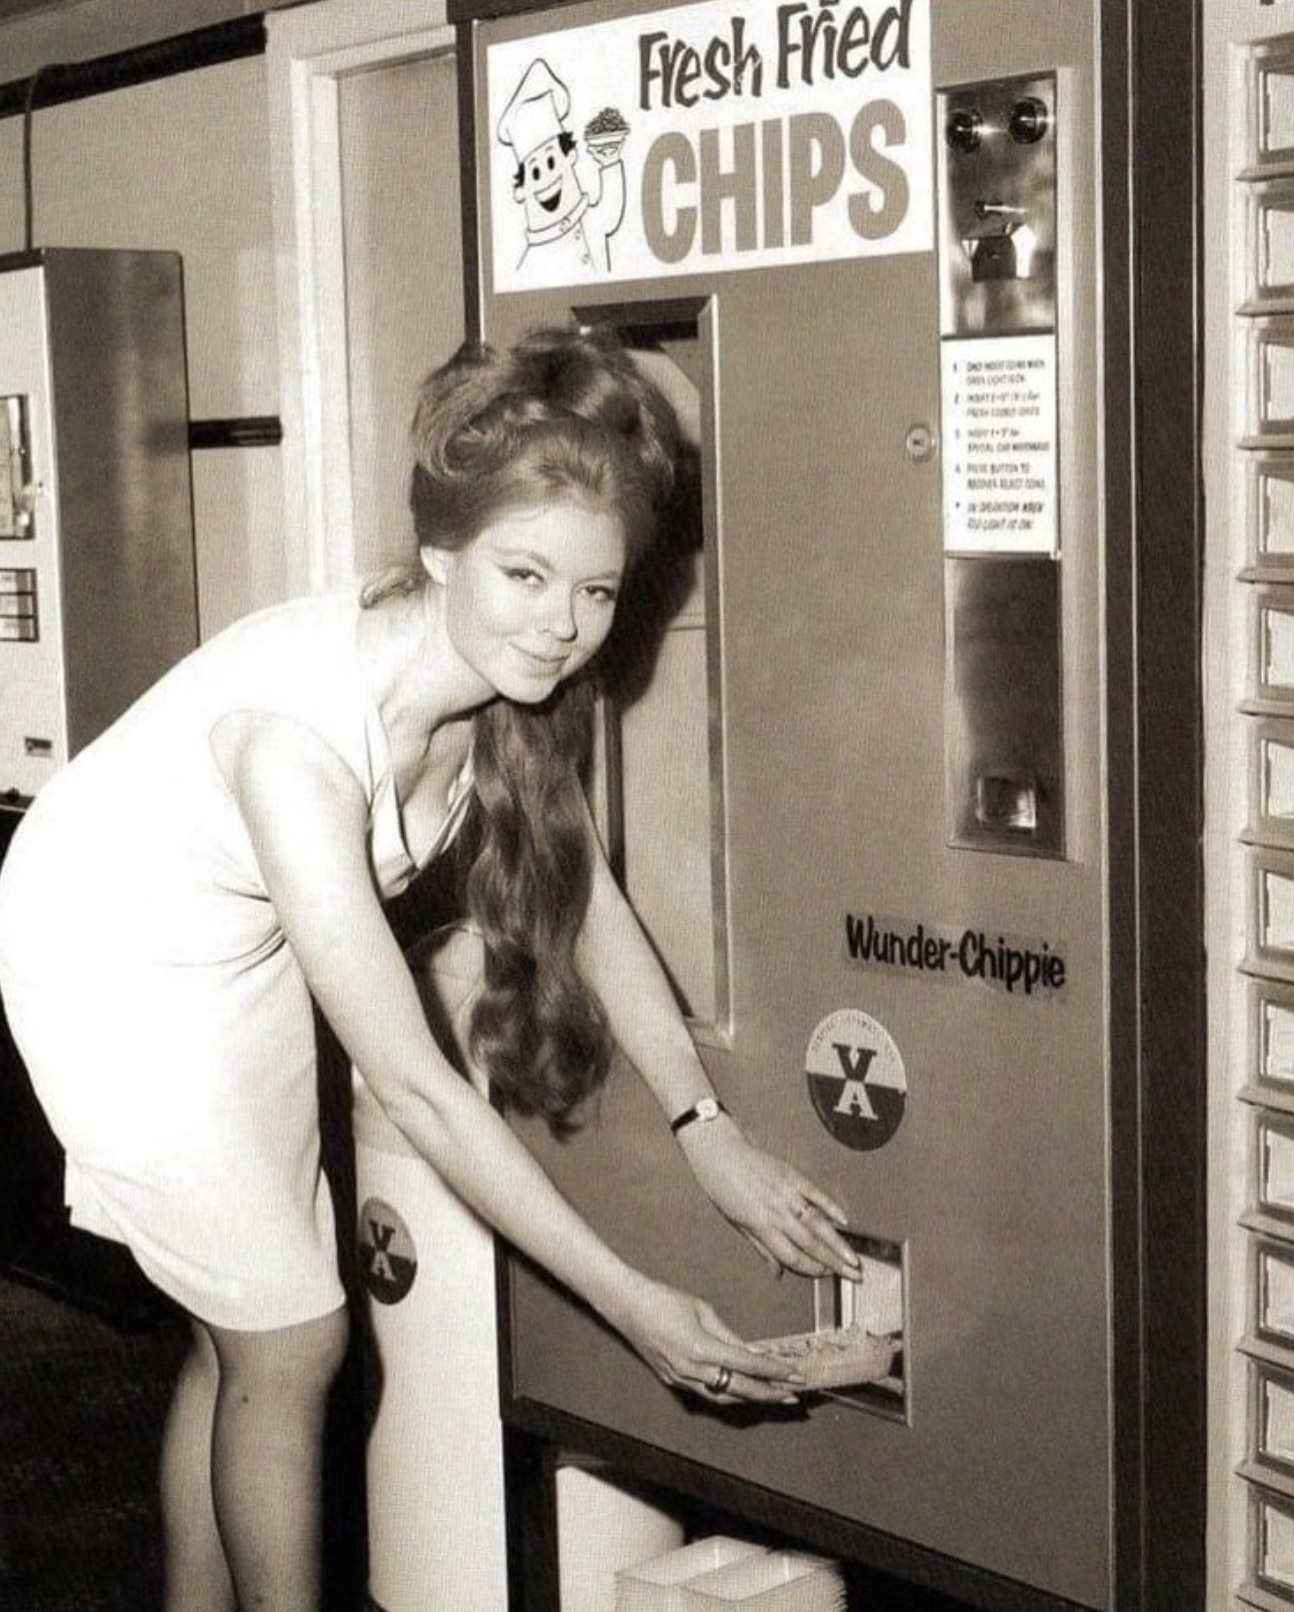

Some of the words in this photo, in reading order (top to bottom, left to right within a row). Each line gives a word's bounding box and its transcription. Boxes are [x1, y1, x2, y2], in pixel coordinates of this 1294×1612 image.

[639, 17, 763, 110] Fresh
[777, 0, 912, 89] Fried
[641, 99, 911, 264] CHIPS
[846, 914, 1066, 995] Wunder-Chippie
